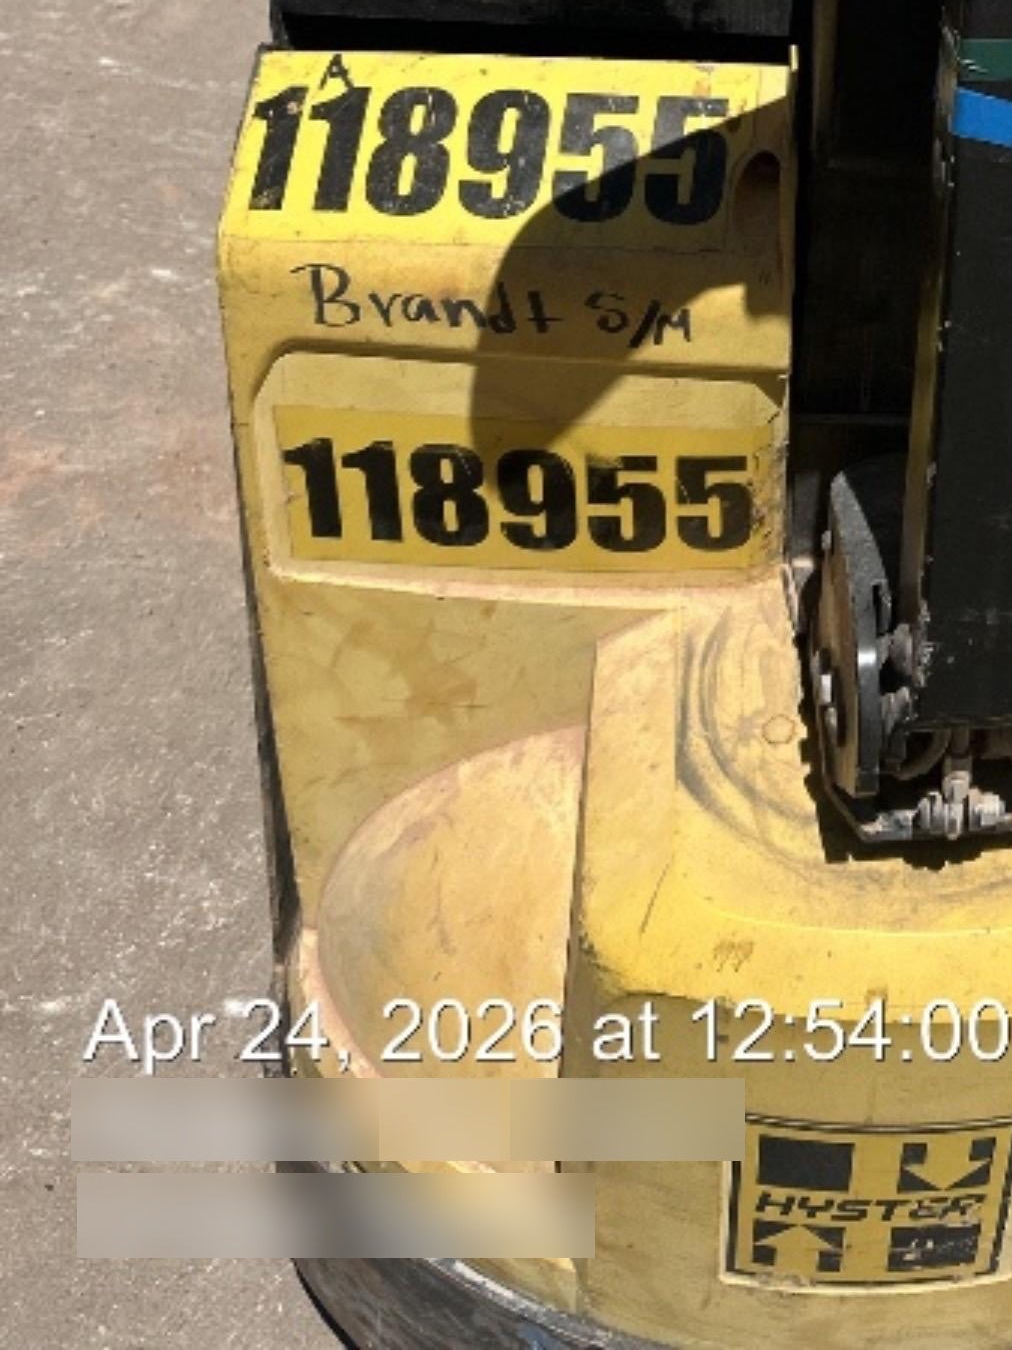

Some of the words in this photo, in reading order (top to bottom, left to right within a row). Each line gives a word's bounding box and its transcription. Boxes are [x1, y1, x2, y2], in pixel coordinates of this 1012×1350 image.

[248, 86, 729, 225] 118955
[289, 262, 563, 337] Brandt
[283, 437, 753, 552] 118955
[755, 1191, 988, 1222] HYSTER
